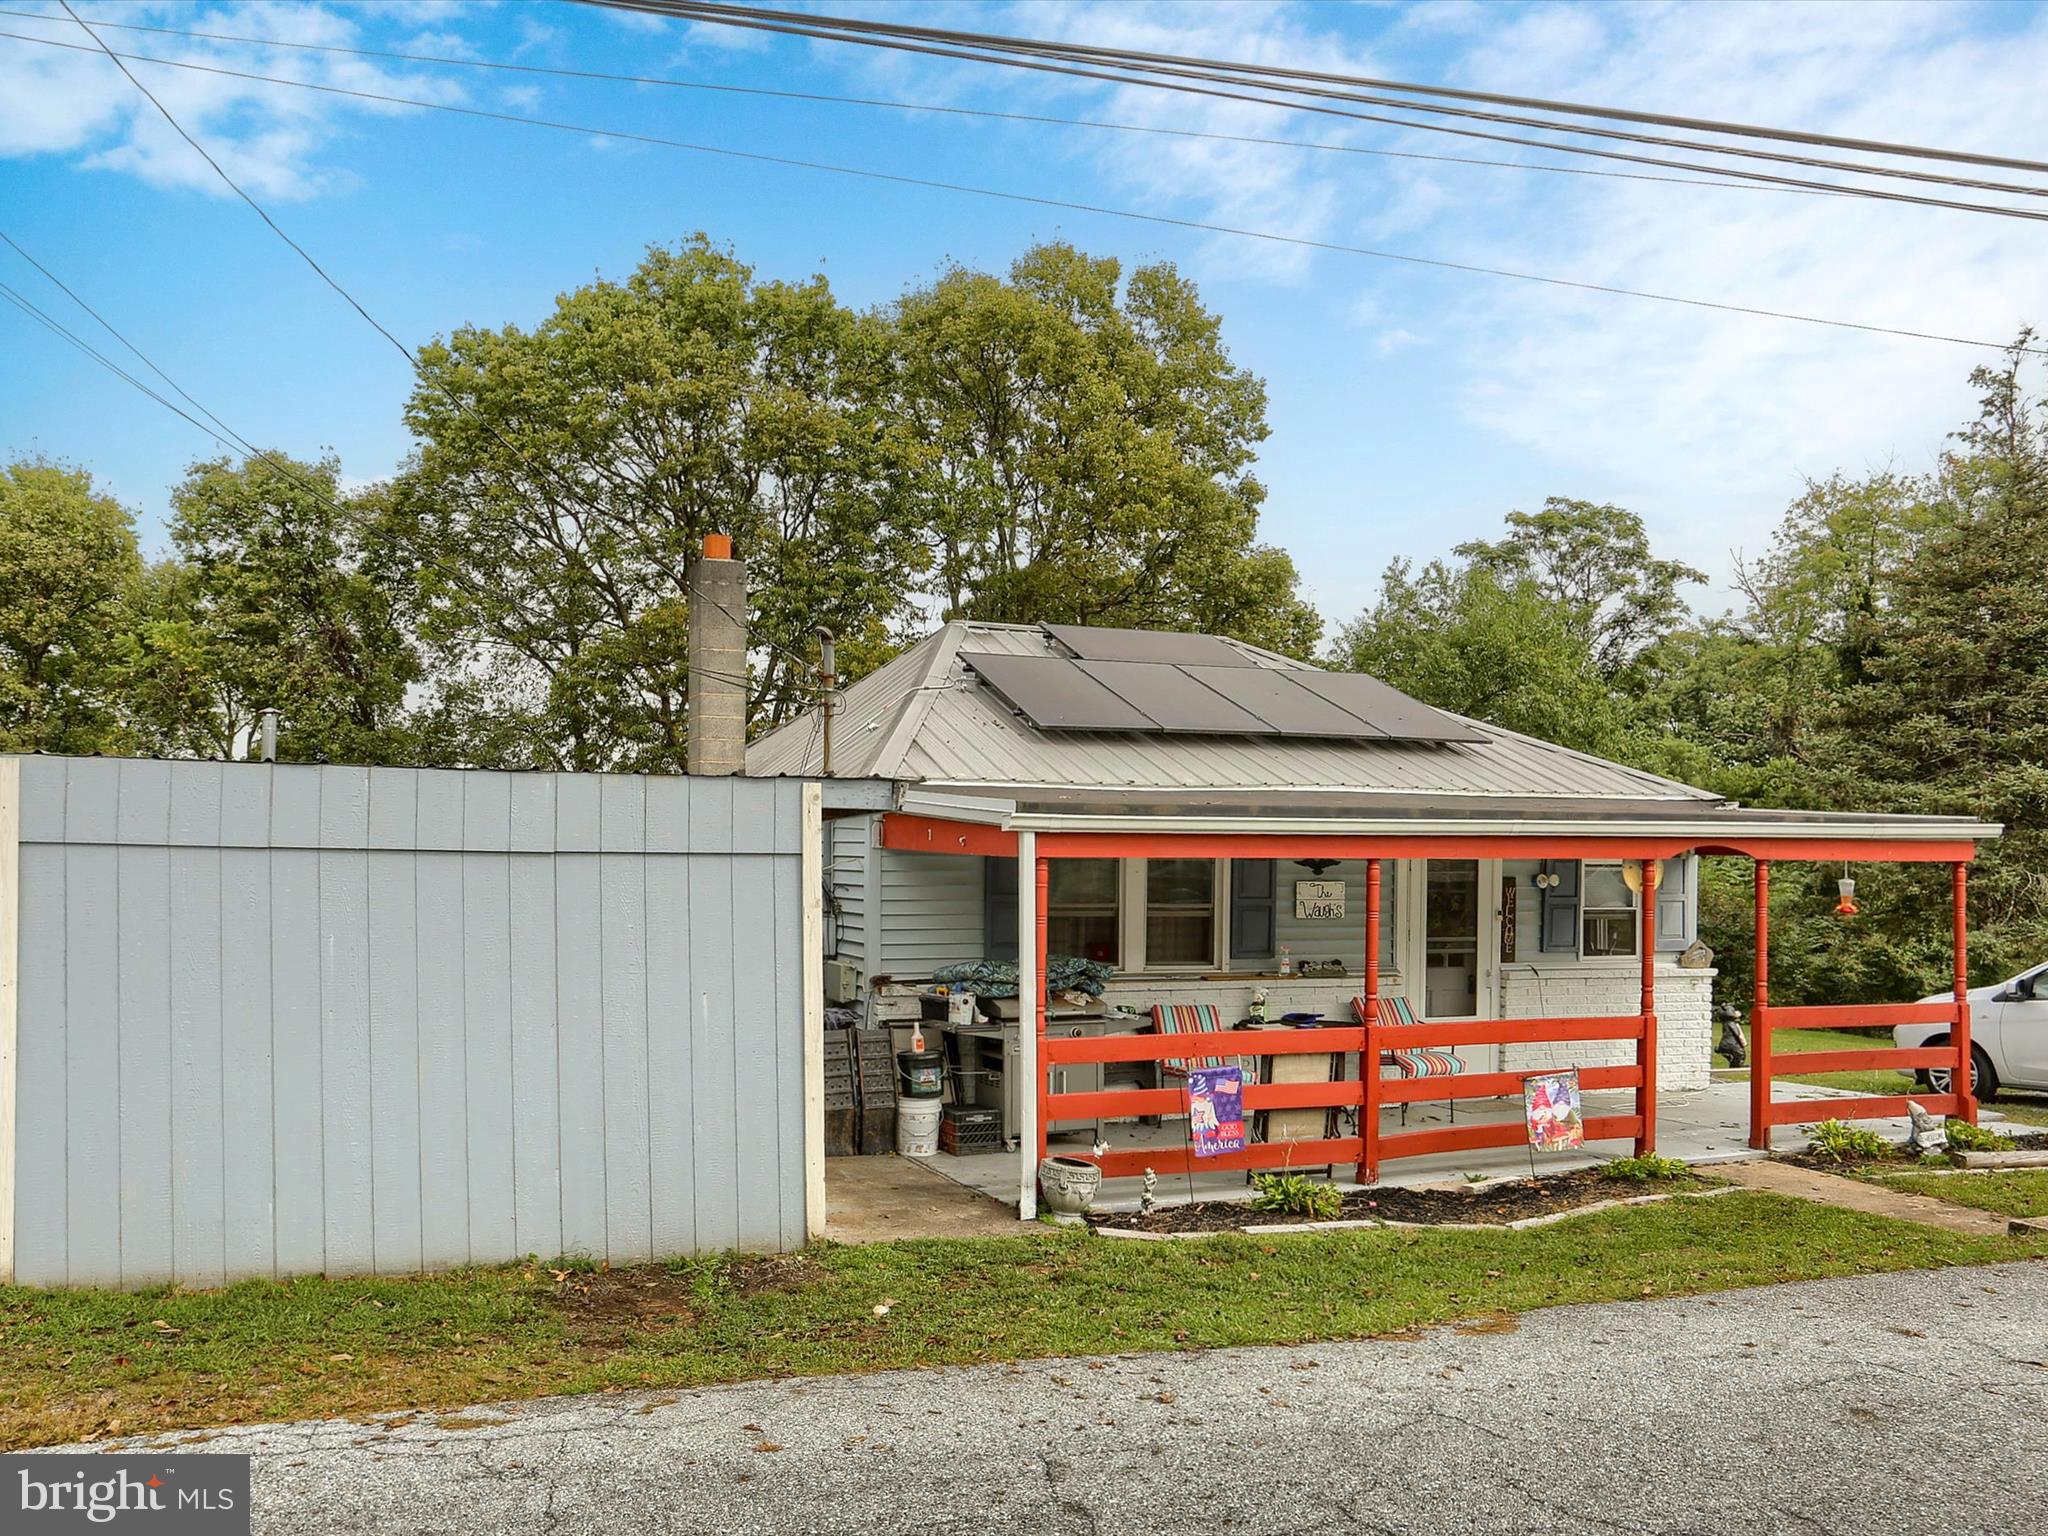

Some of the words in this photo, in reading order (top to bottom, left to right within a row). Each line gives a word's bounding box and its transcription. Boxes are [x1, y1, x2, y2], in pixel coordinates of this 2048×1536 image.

[1309, 882, 1333, 899] The
[1504, 887, 1515, 953] WELCOME
[1220, 1130, 1240, 1138] BLESS
[1221, 1123, 1238, 1131] GOD
[1194, 1138, 1241, 1154] America
